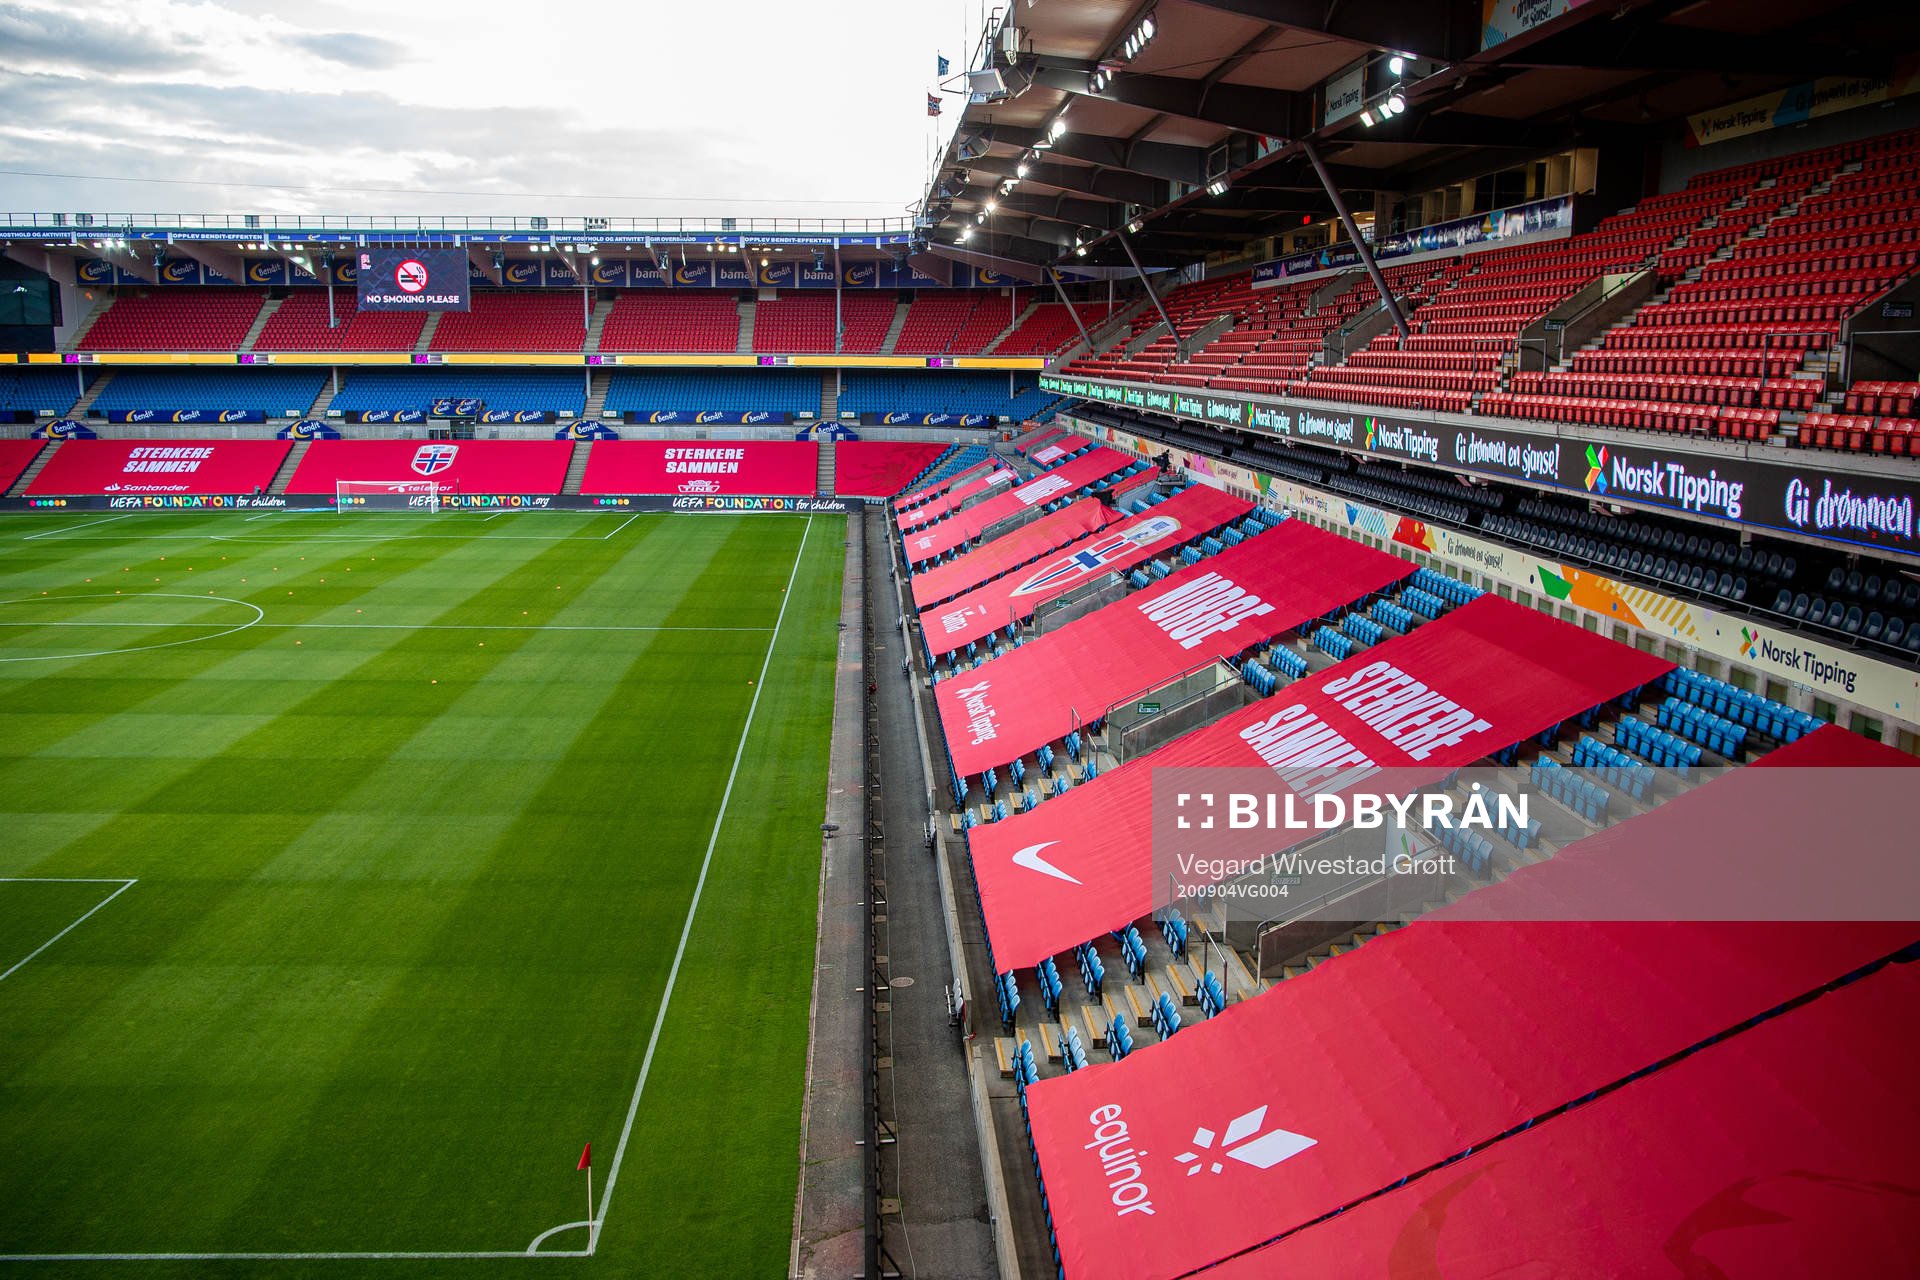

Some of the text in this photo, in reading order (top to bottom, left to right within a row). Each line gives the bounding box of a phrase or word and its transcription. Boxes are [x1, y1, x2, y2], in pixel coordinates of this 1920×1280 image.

[87, 262, 112, 276] Bendit
[171, 262, 195, 277] Bendit
[258, 263, 282, 277] Bendit
[515, 264, 538, 278] Bendit
[601, 264, 624, 277] Bendit
[683, 266, 707, 279] Bendit
[768, 266, 792, 279] Bendit
[803, 268, 834, 280] bama
[852, 266, 875, 280] Bendit
[366, 295, 460, 304] NO SMOKING PLEASE
[133, 410, 154, 422] Bendit
[179, 410, 201, 422] Bendit
[226, 410, 247, 422] Bendit
[369, 410, 390, 422] Bendit
[401, 410, 422, 422] Bendit
[490, 410, 510, 422] Bendit
[521, 410, 542, 422] Bendit
[657, 411, 678, 423] Bendit
[703, 411, 724, 423] Bendit
[748, 411, 769, 423] Bendit
[890, 412, 910, 424] Bendit
[930, 413, 949, 425] Bendit
[965, 414, 984, 426] Bendit
[1255, 407, 1291, 434] Norsk Tipping
[54, 421, 77, 434] Bendit
[298, 421, 321, 434] Bendit
[577, 421, 599, 434] Bendit
[817, 422, 839, 435] Bendit
[1378, 426, 1439, 462] Norsk Tipping
[129, 447, 214, 459] STERKERE
[664, 448, 745, 460] STERKERE
[1455, 433, 1561, 480] Gi drømmen en sjanse!
[123, 461, 201, 473] SAMMEN
[665, 461, 739, 474] SAMMEN
[121, 484, 190, 492] Santander
[1612, 455, 1744, 519] Norsk Tipping
[110, 496, 287, 509] UEFA FOUNDATION for children
[442, 496, 532, 507] FOUNDATION
[672, 497, 846, 510] UEFA FOUNDATION for children
[1785, 477, 1913, 541] Gi drømmen
[1137, 571, 1276, 650] NORGE
[1761, 639, 1857, 693] Norsk Tipping
[1321, 660, 1494, 762] STERKERE
[964, 691, 1001, 745] Norsk Tipping
[1239, 702, 1384, 806] SAMMEN
[1084, 1103, 1157, 1217] equinor
